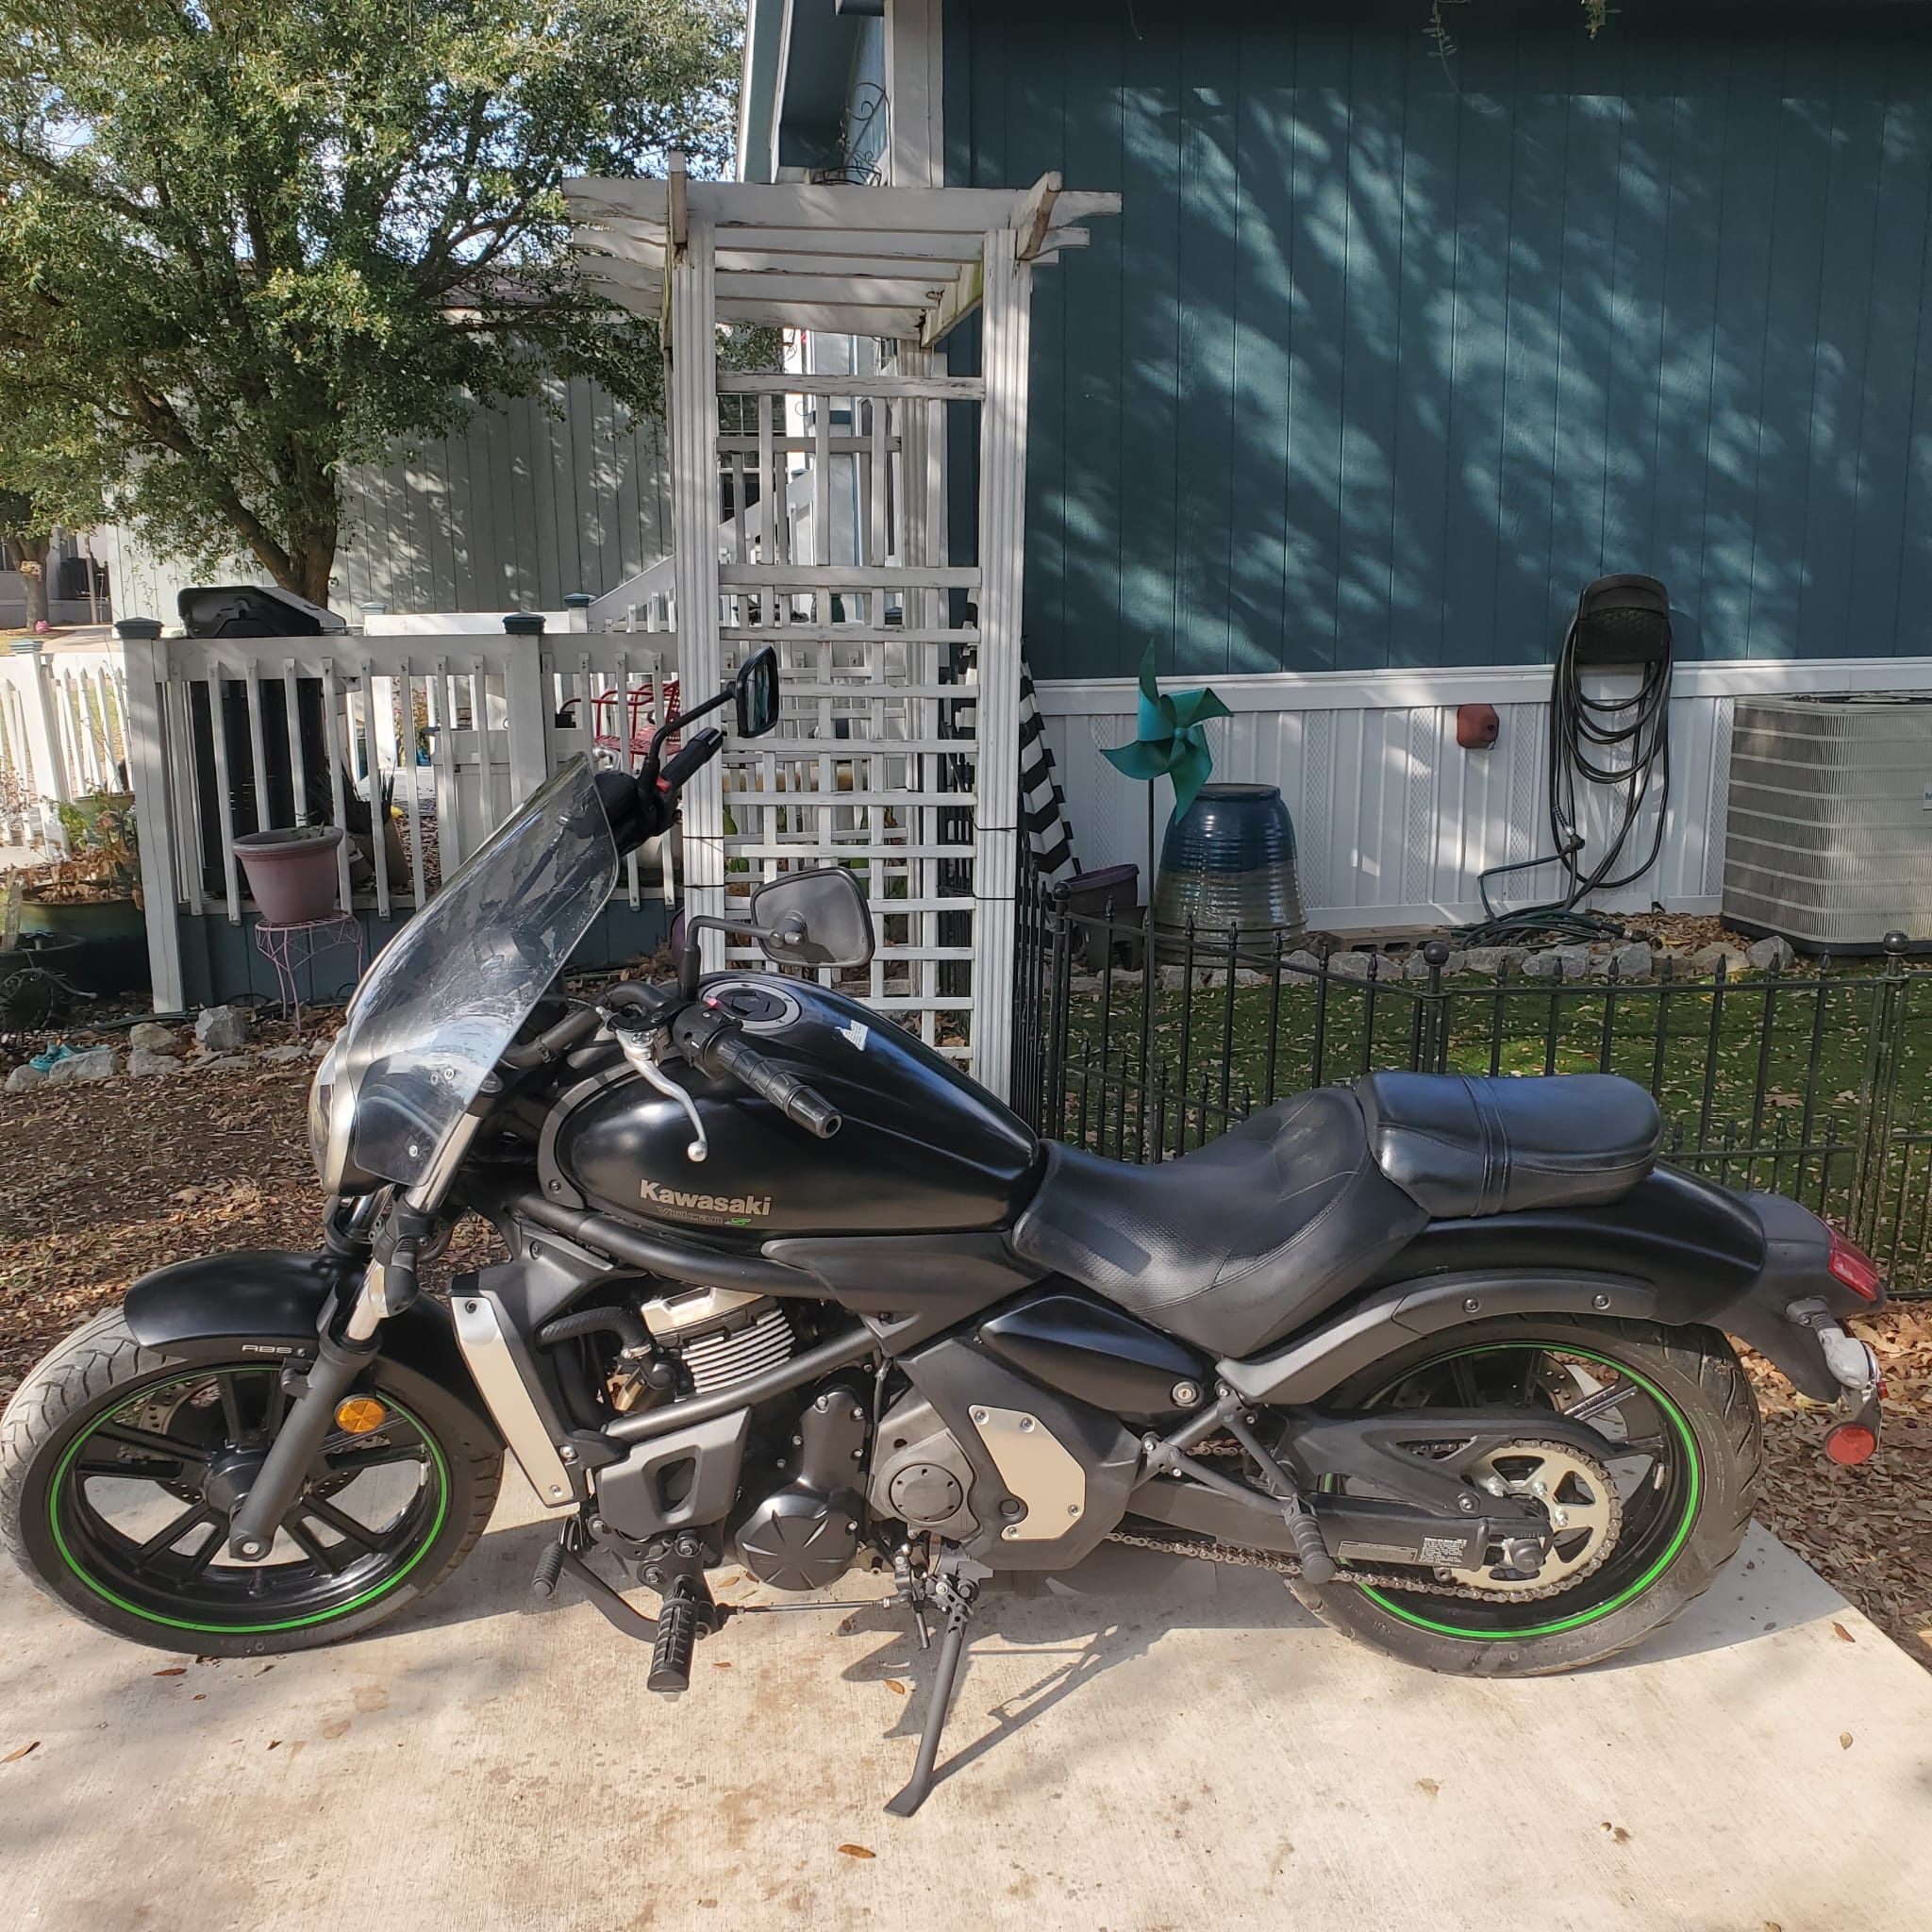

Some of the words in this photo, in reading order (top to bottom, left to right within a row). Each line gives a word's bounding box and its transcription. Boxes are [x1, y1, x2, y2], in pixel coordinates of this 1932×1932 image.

[641, 1179, 771, 1215] Kawasaki
[657, 1206, 723, 1224] Vulcan
[724, 1217, 752, 1227] S
[242, 1345, 292, 1354] ABS
